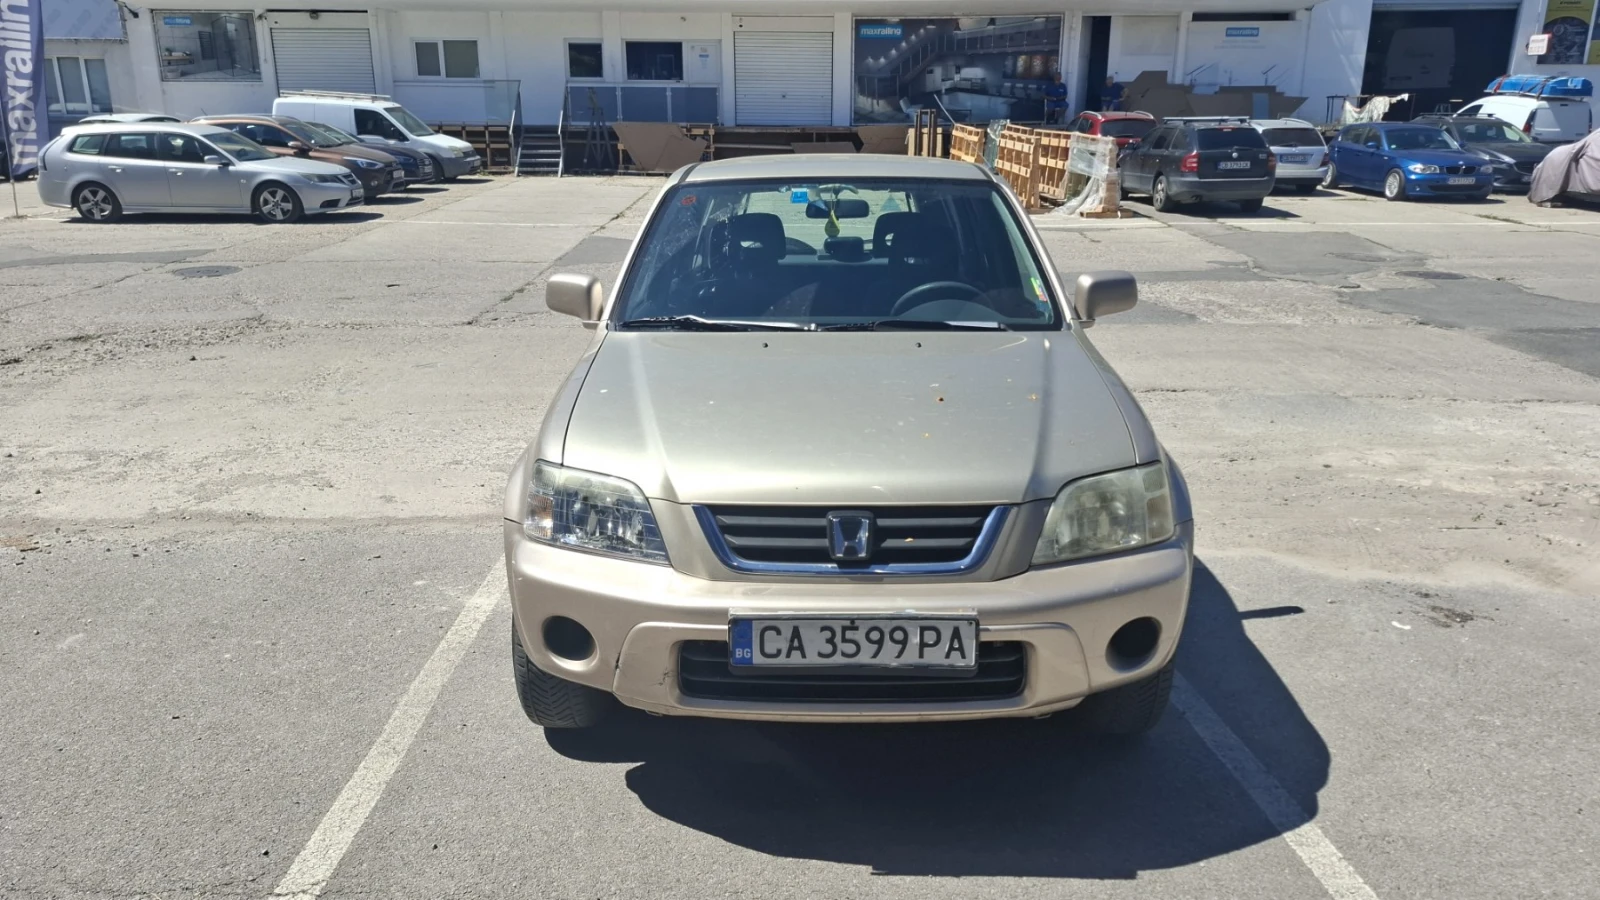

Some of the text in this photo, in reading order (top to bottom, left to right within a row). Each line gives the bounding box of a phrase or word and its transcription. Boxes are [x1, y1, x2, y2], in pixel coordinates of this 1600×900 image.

[860, 26, 902, 36] maxrailing
[758, 625, 967, 660] CA 3599 PA
[735, 648, 752, 658] BG
